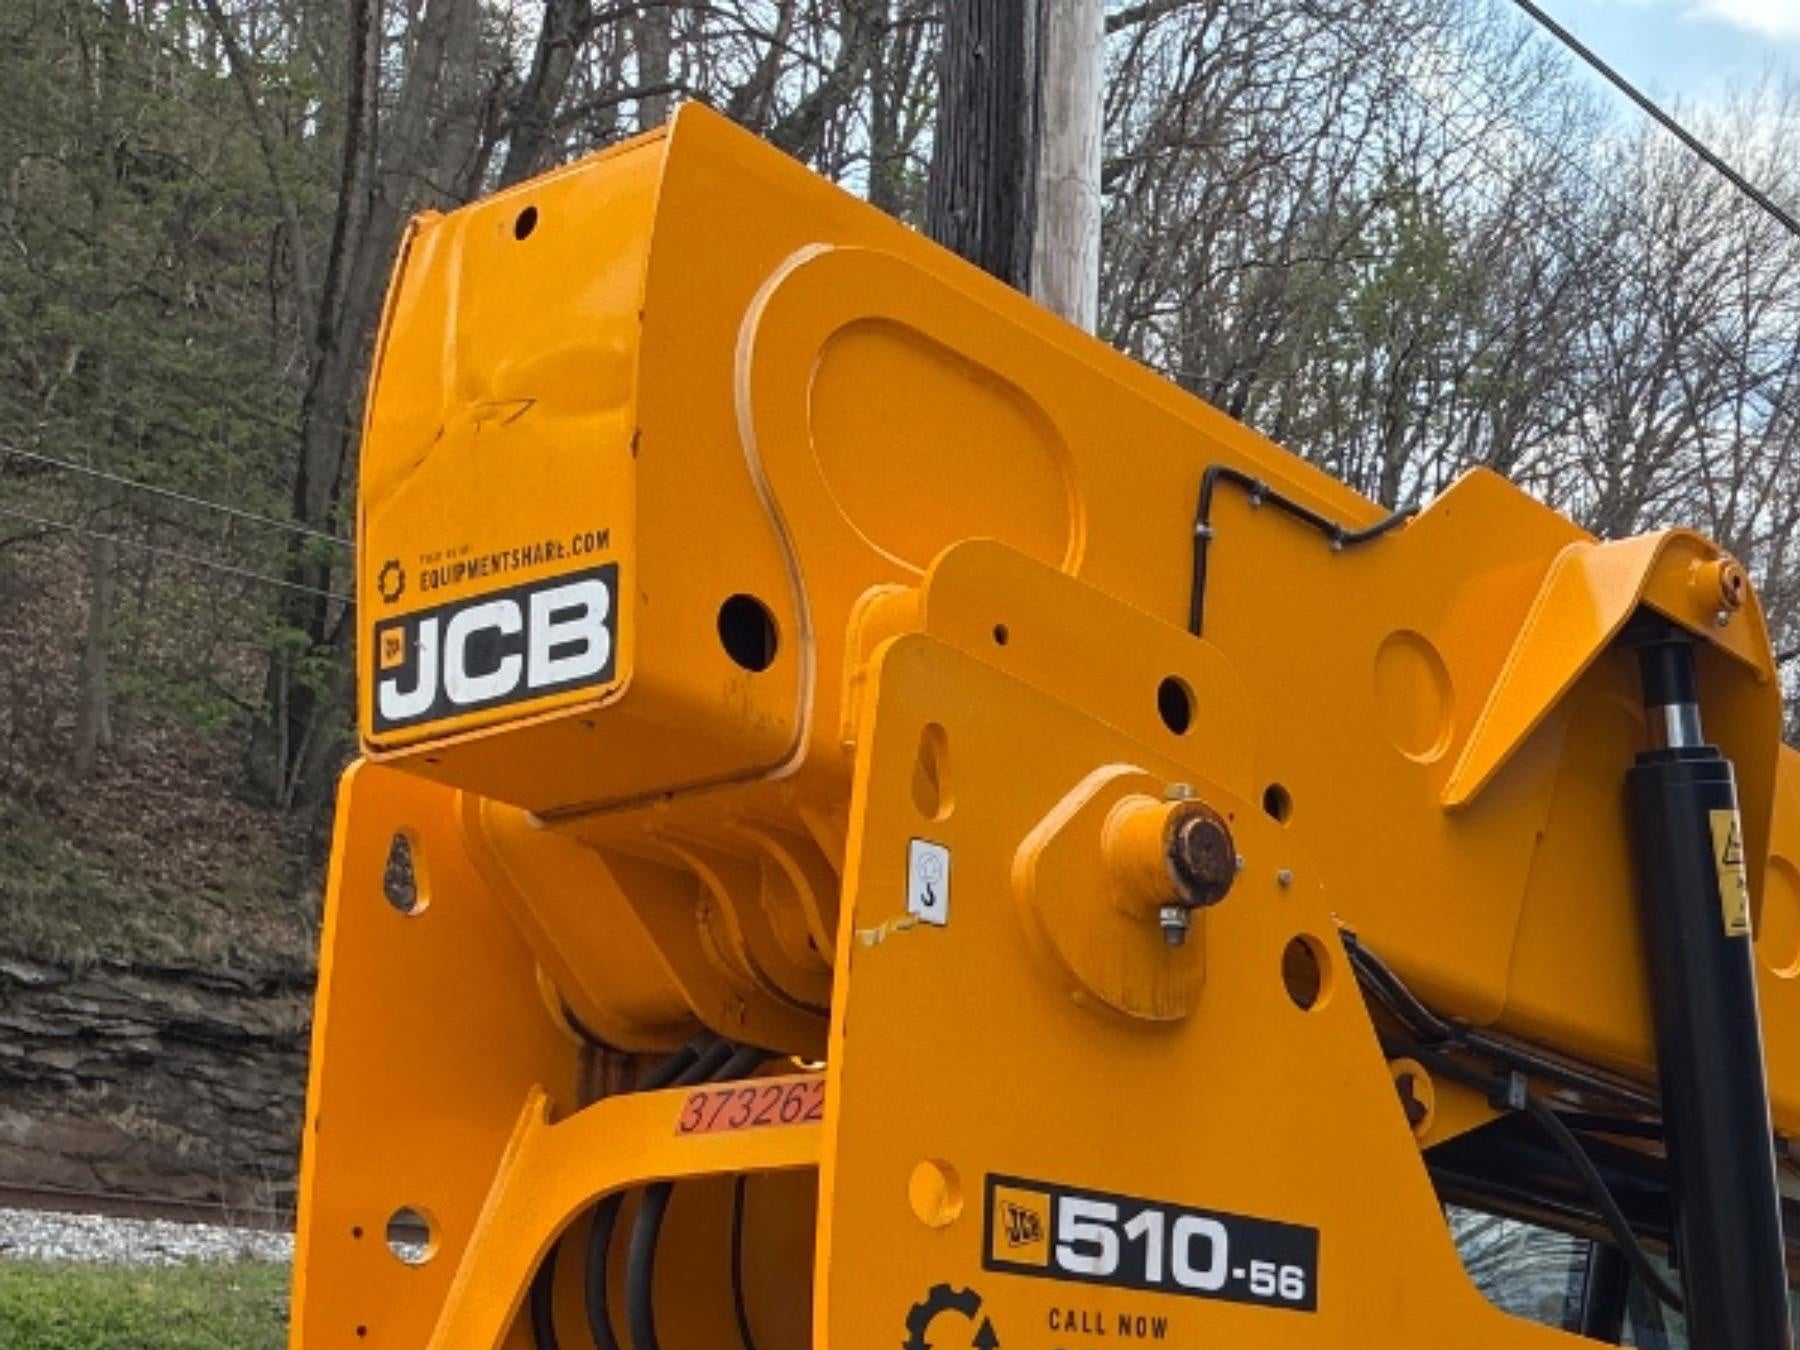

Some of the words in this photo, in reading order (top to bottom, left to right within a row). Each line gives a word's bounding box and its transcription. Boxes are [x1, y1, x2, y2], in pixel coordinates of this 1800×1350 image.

[419, 528, 610, 592] EQUIPMENTSHARE.COM
[380, 578, 610, 721] JCB
[1055, 1196, 1305, 1300] 510-56
[1049, 1307, 1105, 1335] CALL
[1118, 1313, 1168, 1340] NOW
